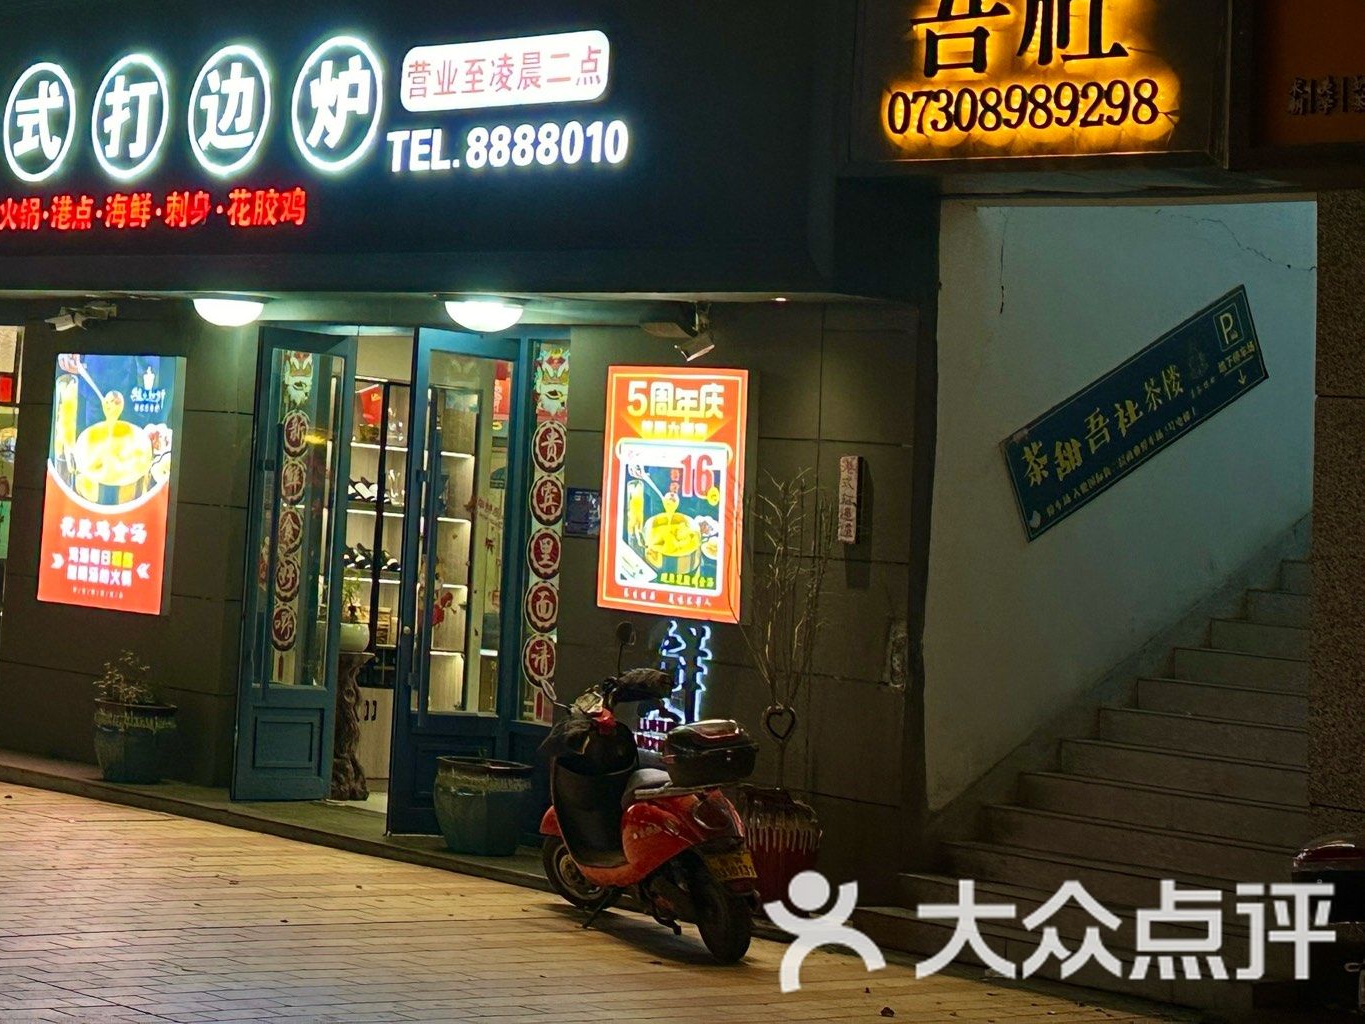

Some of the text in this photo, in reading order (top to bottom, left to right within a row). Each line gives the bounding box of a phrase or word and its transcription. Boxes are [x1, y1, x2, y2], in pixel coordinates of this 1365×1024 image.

[407, 45, 604, 103] 营业至凌晨二点
[887, 79, 1160, 135] 07308989298
[1220, 312, 1237, 345] P
[626, 380, 726, 420] 5周年庆
